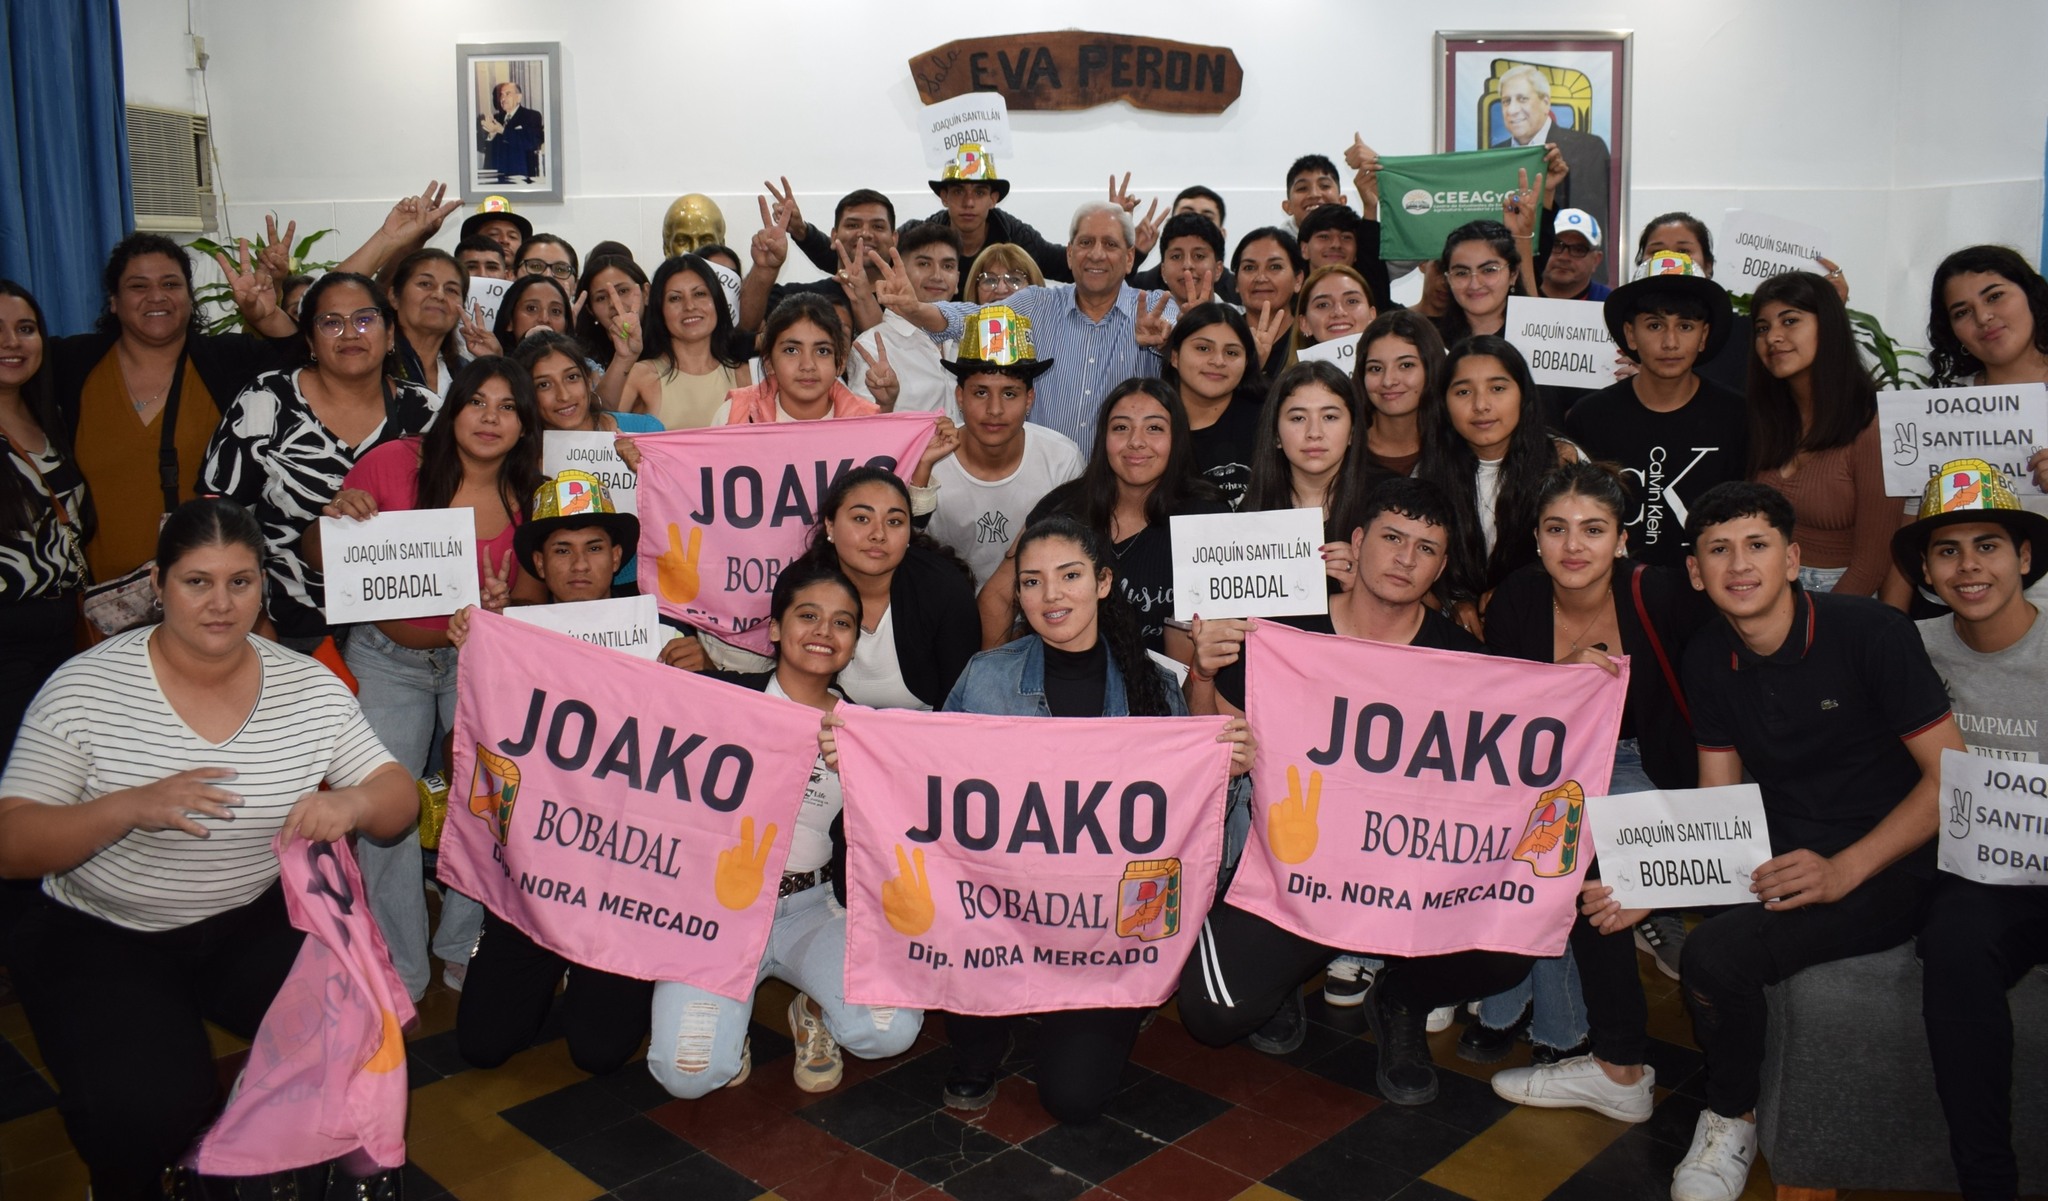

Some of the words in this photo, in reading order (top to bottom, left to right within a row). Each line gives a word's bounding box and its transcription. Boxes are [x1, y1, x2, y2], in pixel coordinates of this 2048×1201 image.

[917, 46, 962, 95] Sala
[970, 46, 1062, 93] EVA
[1078, 44, 1226, 94] PERON
[932, 112, 962, 133] JOAQUÍN
[962, 108, 1001, 122] SANTILLÁN
[944, 128, 991, 150] BOBADAL
[1736, 232, 1774, 250] JOAQUÍN
[1776, 240, 1821, 260] SANTILLÁN
[1522, 321, 1564, 341] JOAQUÍN
[1532, 350, 1596, 374] BOBADAL
[1926, 395, 2020, 414] JOAQUIN
[1922, 428, 2033, 447] SANTILLAN
[566, 446, 613, 464] JOAQUÍN
[1648, 446, 1666, 501] Calvin
[1645, 505, 1663, 544] Klein
[344, 540, 397, 565] JOAQUÍN
[400, 536, 462, 560] SANTILLÁN
[1192, 541, 1244, 566] JOAQUÍN
[1246, 537, 1310, 560] SANTILLÁN
[363, 574, 442, 601] BOBADAL
[1210, 575, 1288, 600] BOBADAL
[497, 688, 754, 812] JOAKO
[1306, 695, 1567, 788] JOAKO
[1984, 770, 2048, 798] JOAQ
[905, 775, 1167, 854] JOAKO
[533, 800, 682, 880] BOBADAL
[1361, 810, 1511, 864] BOBADAL
[1616, 820, 1675, 847] JOAQUÍN
[1676, 816, 1752, 842] SANTILLÁN
[1640, 858, 1731, 887] BOBADAL
[957, 880, 1108, 930] BOBADAL
[1288, 872, 1332, 901] Dip.
[1341, 881, 1412, 910] NORA
[1422, 880, 1534, 910] MERCADO
[520, 872, 587, 908] NORA
[598, 891, 720, 942] MERCADO
[908, 941, 954, 970] Dip.
[963, 944, 1024, 969] NORA
[1034, 945, 1159, 966] MERCADO
